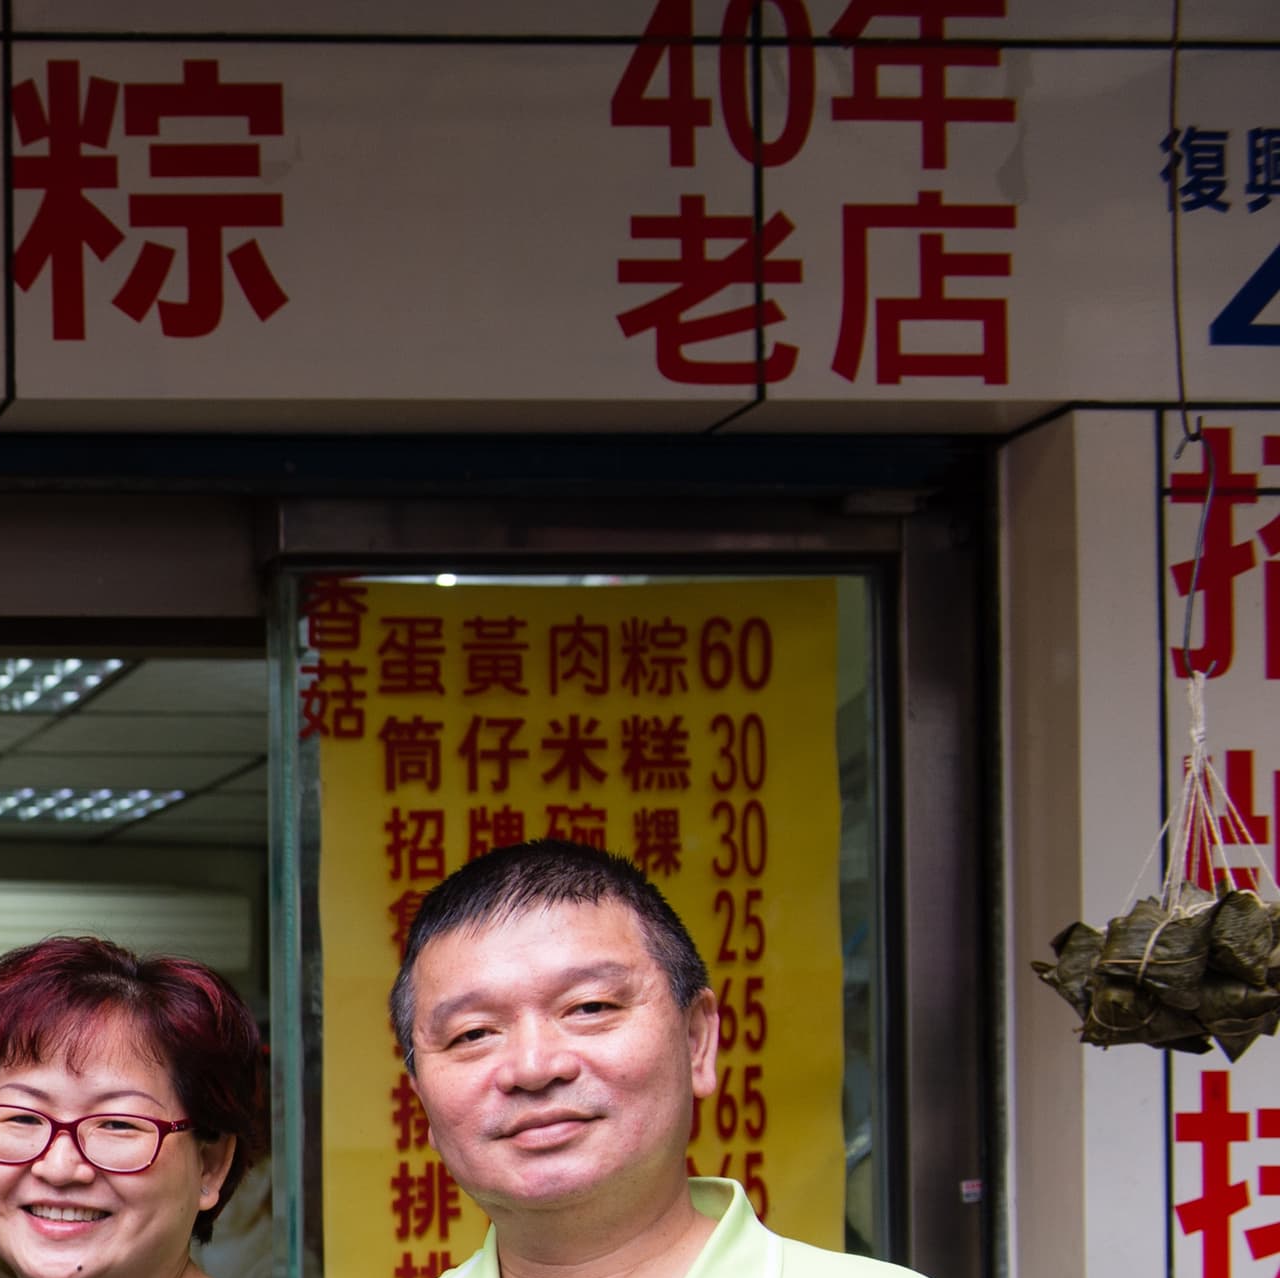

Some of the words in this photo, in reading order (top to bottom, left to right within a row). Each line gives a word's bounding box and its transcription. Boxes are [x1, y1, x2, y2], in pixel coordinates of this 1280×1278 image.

[615, 190, 1017, 386] 老店
[299, 568, 368, 740] 香菇
[376, 614, 689, 697] 蛋黃肉粽
[698, 616, 772, 691] 60
[376, 713, 691, 793] 筒仔米糕
[710, 713, 767, 792] 30
[711, 800, 767, 878] 30
[713, 889, 766, 964] 25
[718, 976, 768, 1053] 65
[715, 1065, 768, 1142] 65
